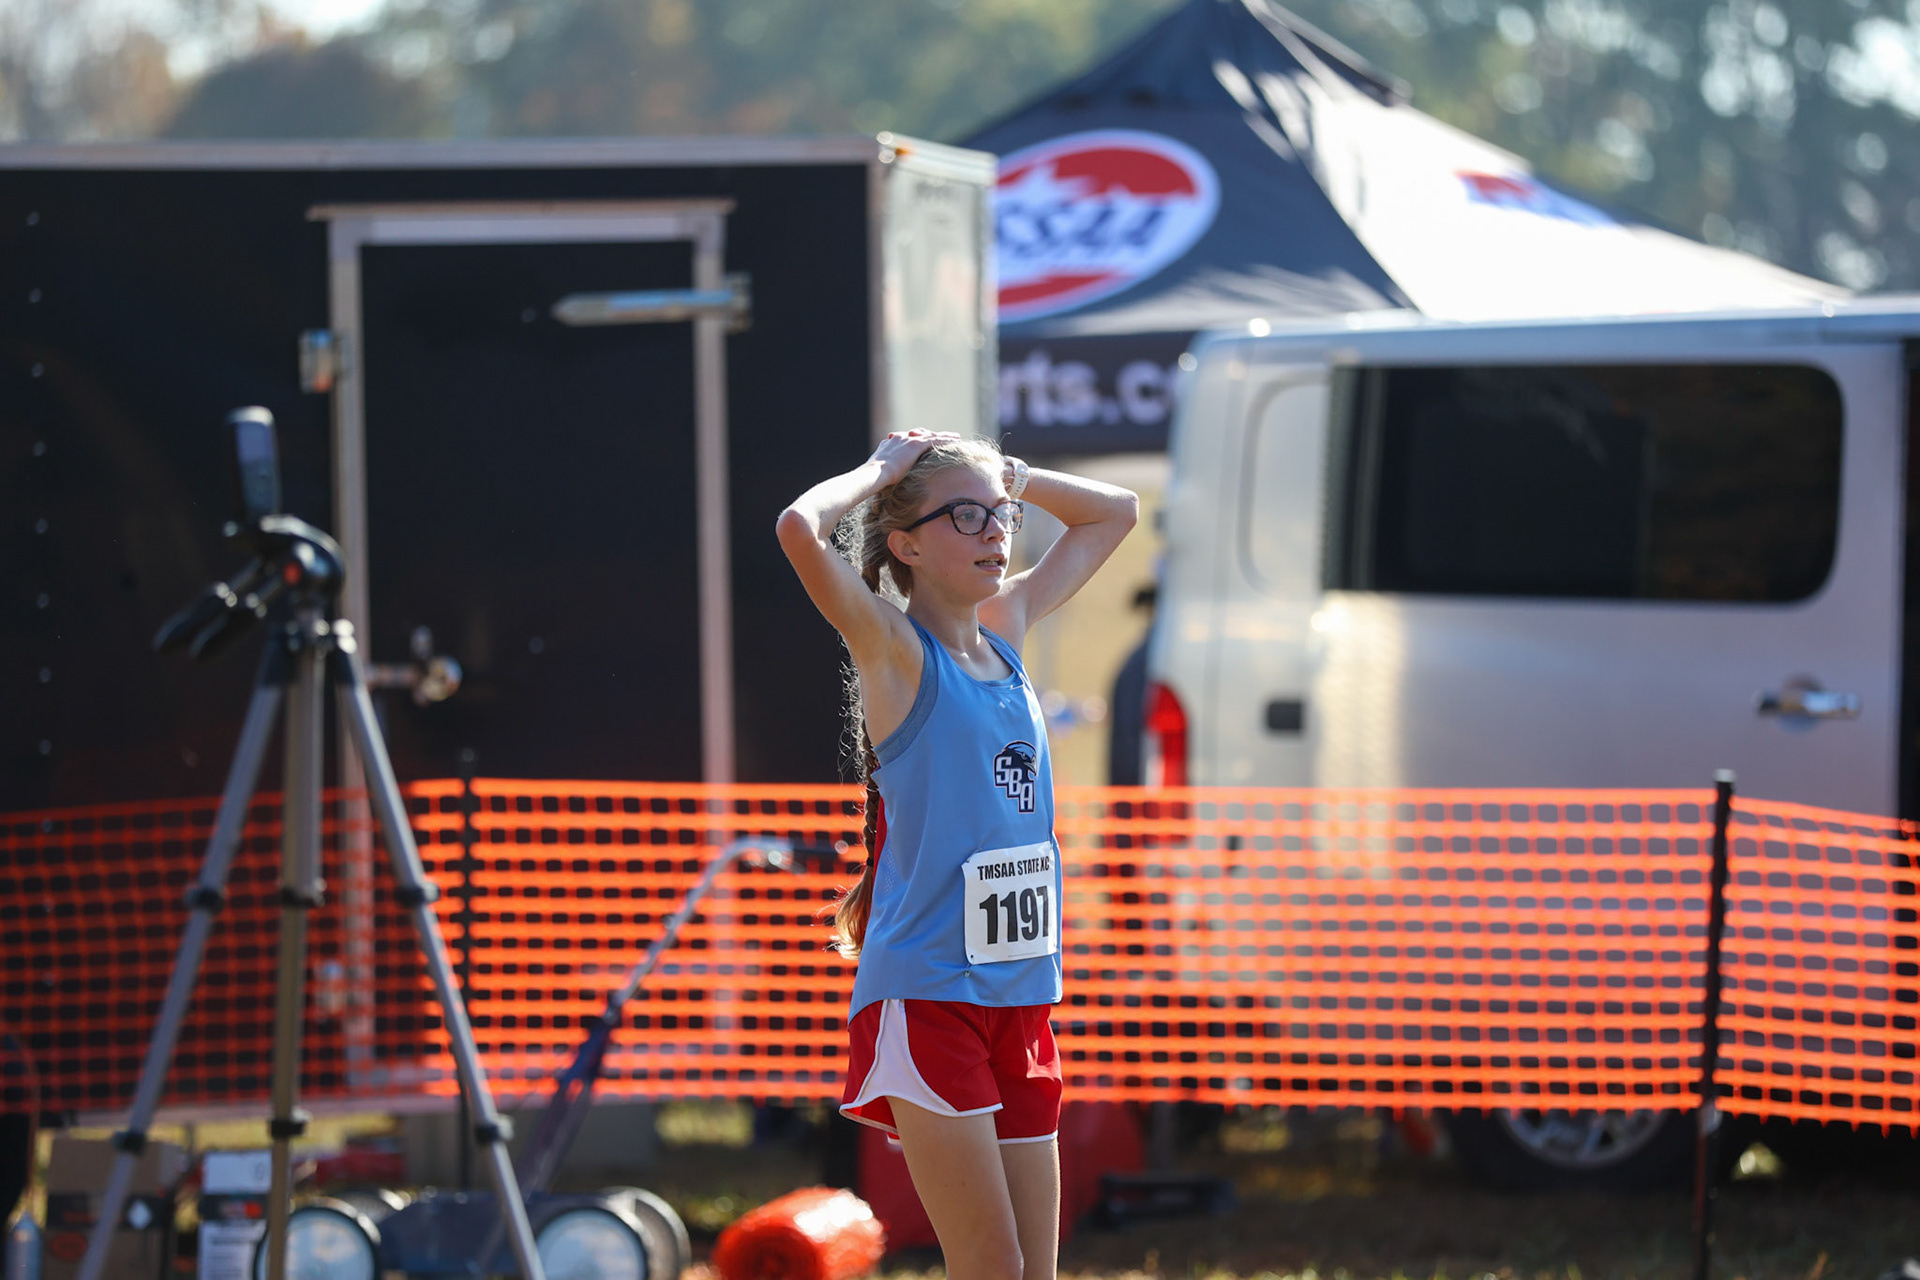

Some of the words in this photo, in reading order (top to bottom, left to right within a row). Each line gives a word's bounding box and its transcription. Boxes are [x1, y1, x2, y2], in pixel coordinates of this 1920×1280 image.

[1000, 350, 1176, 426] rts.c
[995, 755, 1034, 811] SBA
[977, 862, 1016, 881] TMSAA
[1017, 858, 1040, 876] STATE
[1040, 856, 1050, 872] XC
[979, 885, 1049, 946] 1197
